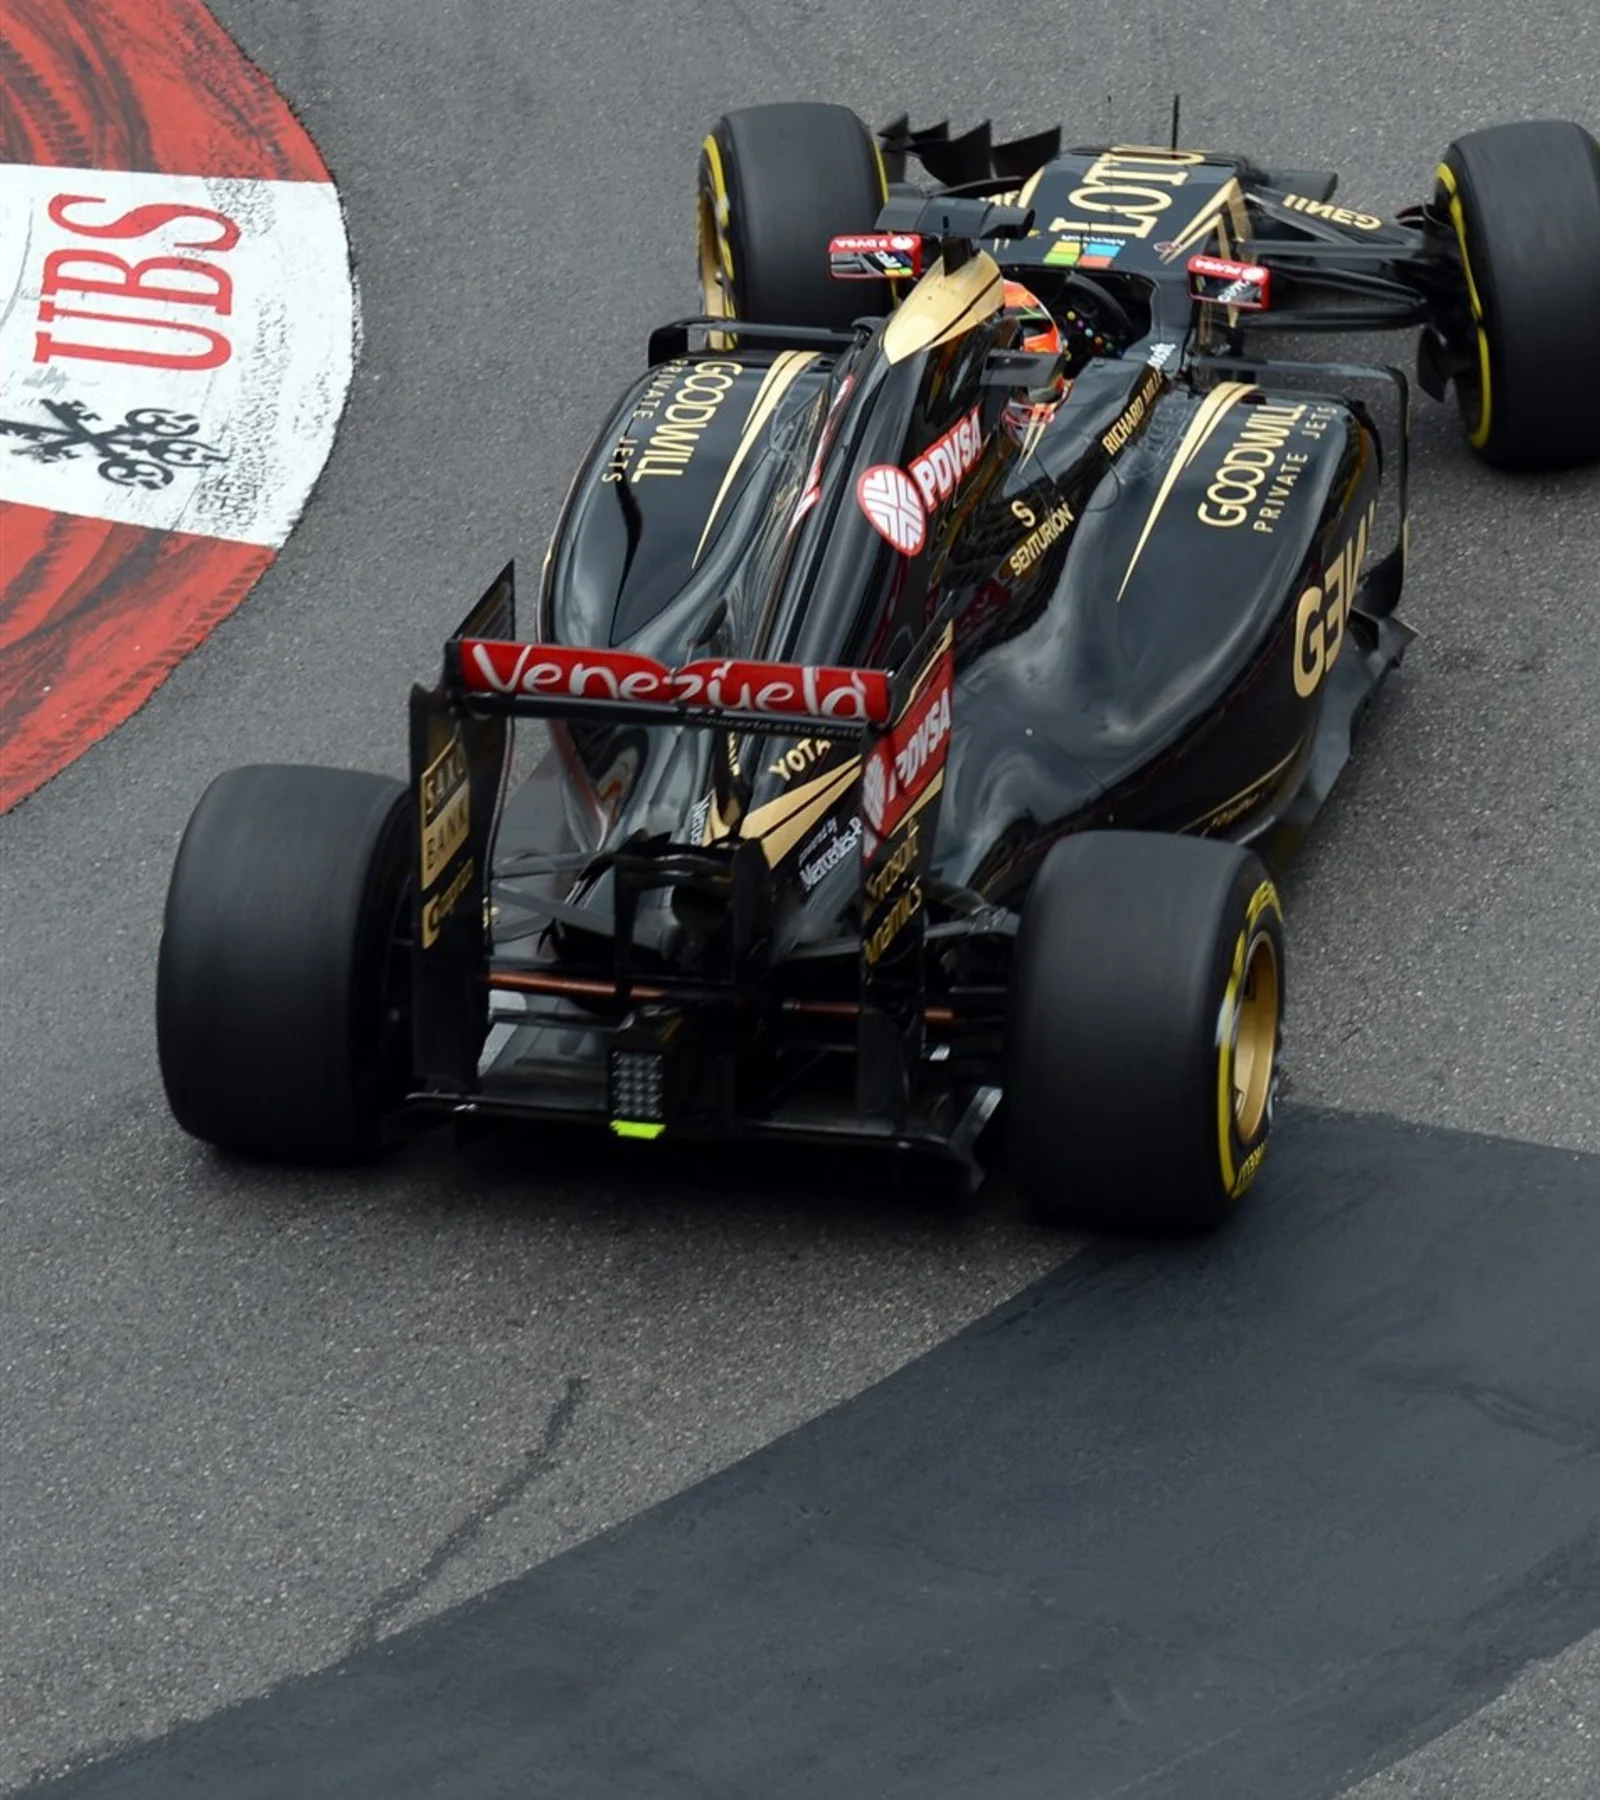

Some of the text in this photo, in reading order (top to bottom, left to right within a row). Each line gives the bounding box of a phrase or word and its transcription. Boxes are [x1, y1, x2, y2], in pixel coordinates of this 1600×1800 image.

[33, 193, 242, 371] UBS
[601, 359, 689, 483] PRIVATE JETS
[631, 361, 743, 483] GOODWILL
[913, 407, 984, 506] PDVSA
[1102, 397, 1145, 456] RICHARD
[1197, 404, 1307, 527] GOODWILL
[1252, 453, 1309, 533] PRIVATE
[472, 643, 870, 719] Venezuela
[888, 686, 952, 803] PDVSA
